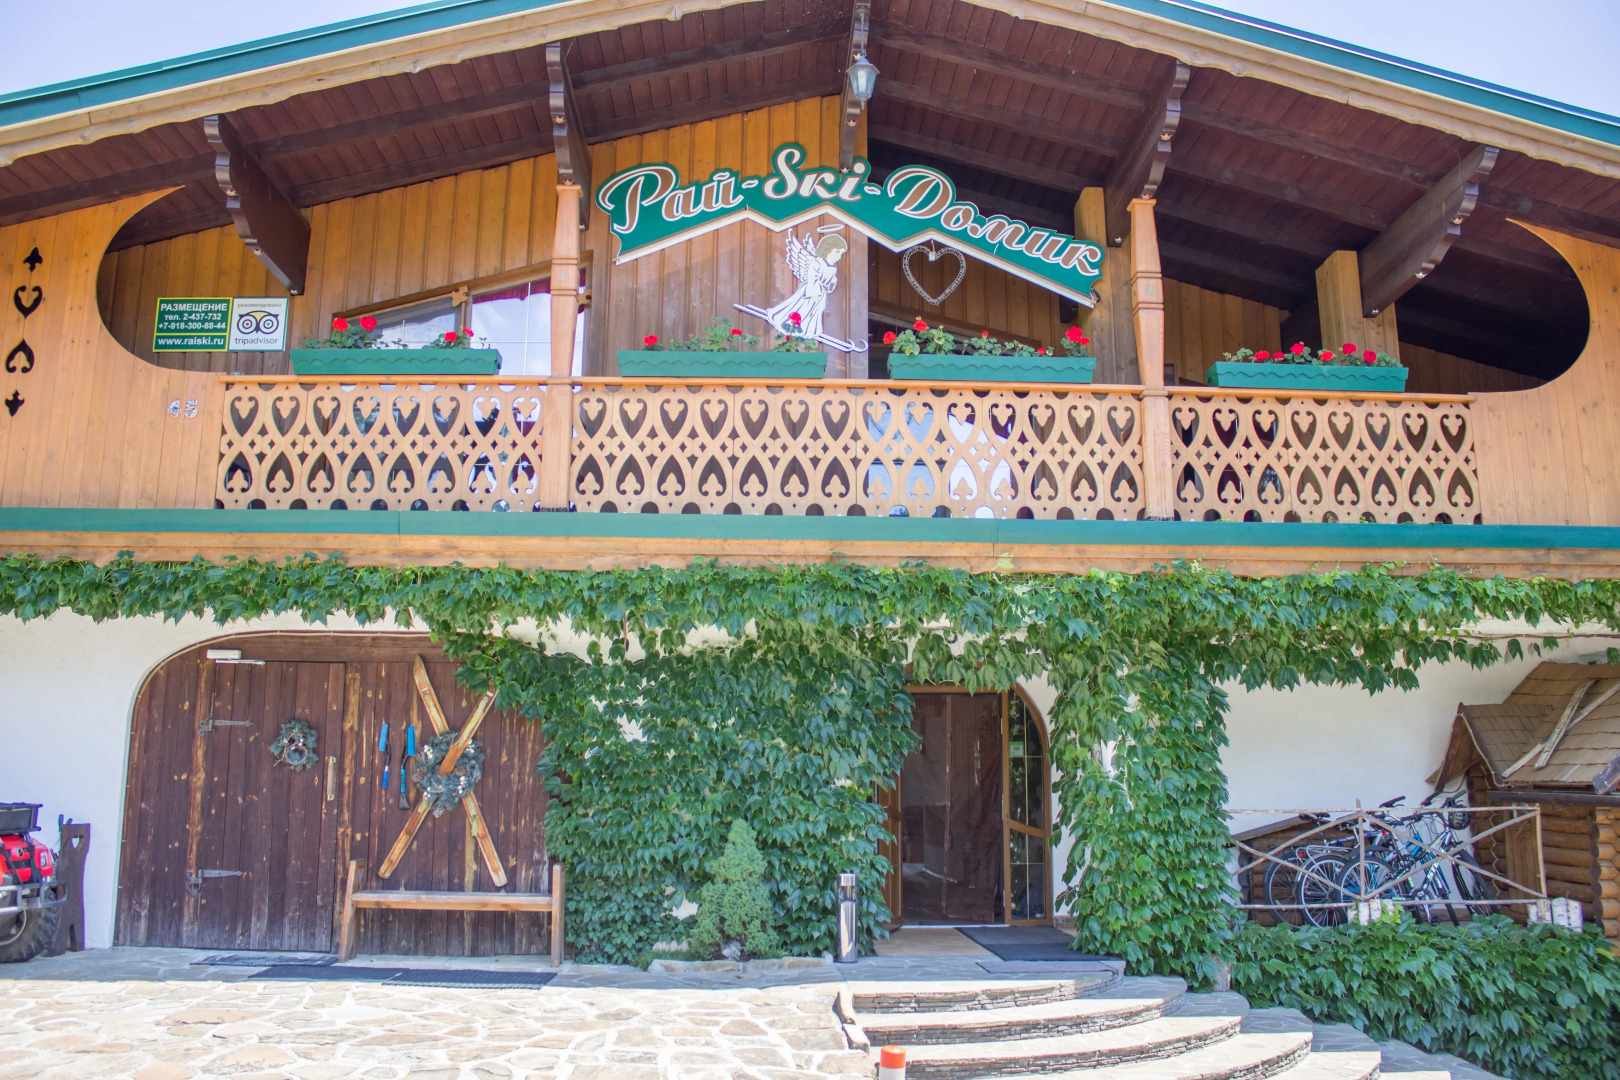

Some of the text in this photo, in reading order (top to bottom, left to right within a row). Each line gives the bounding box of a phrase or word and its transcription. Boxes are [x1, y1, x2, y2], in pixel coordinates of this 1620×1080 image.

[160, 303, 228, 312] РАЗМЕЩЕНИЕ
[183, 313, 222, 321] 2-437-732
[158, 322, 226, 330] +7-918-300-88-44
[158, 337, 224, 345] www.raiski.ru
[234, 337, 279, 346] tripadvisor
[167, 399, 198, 418] 45
